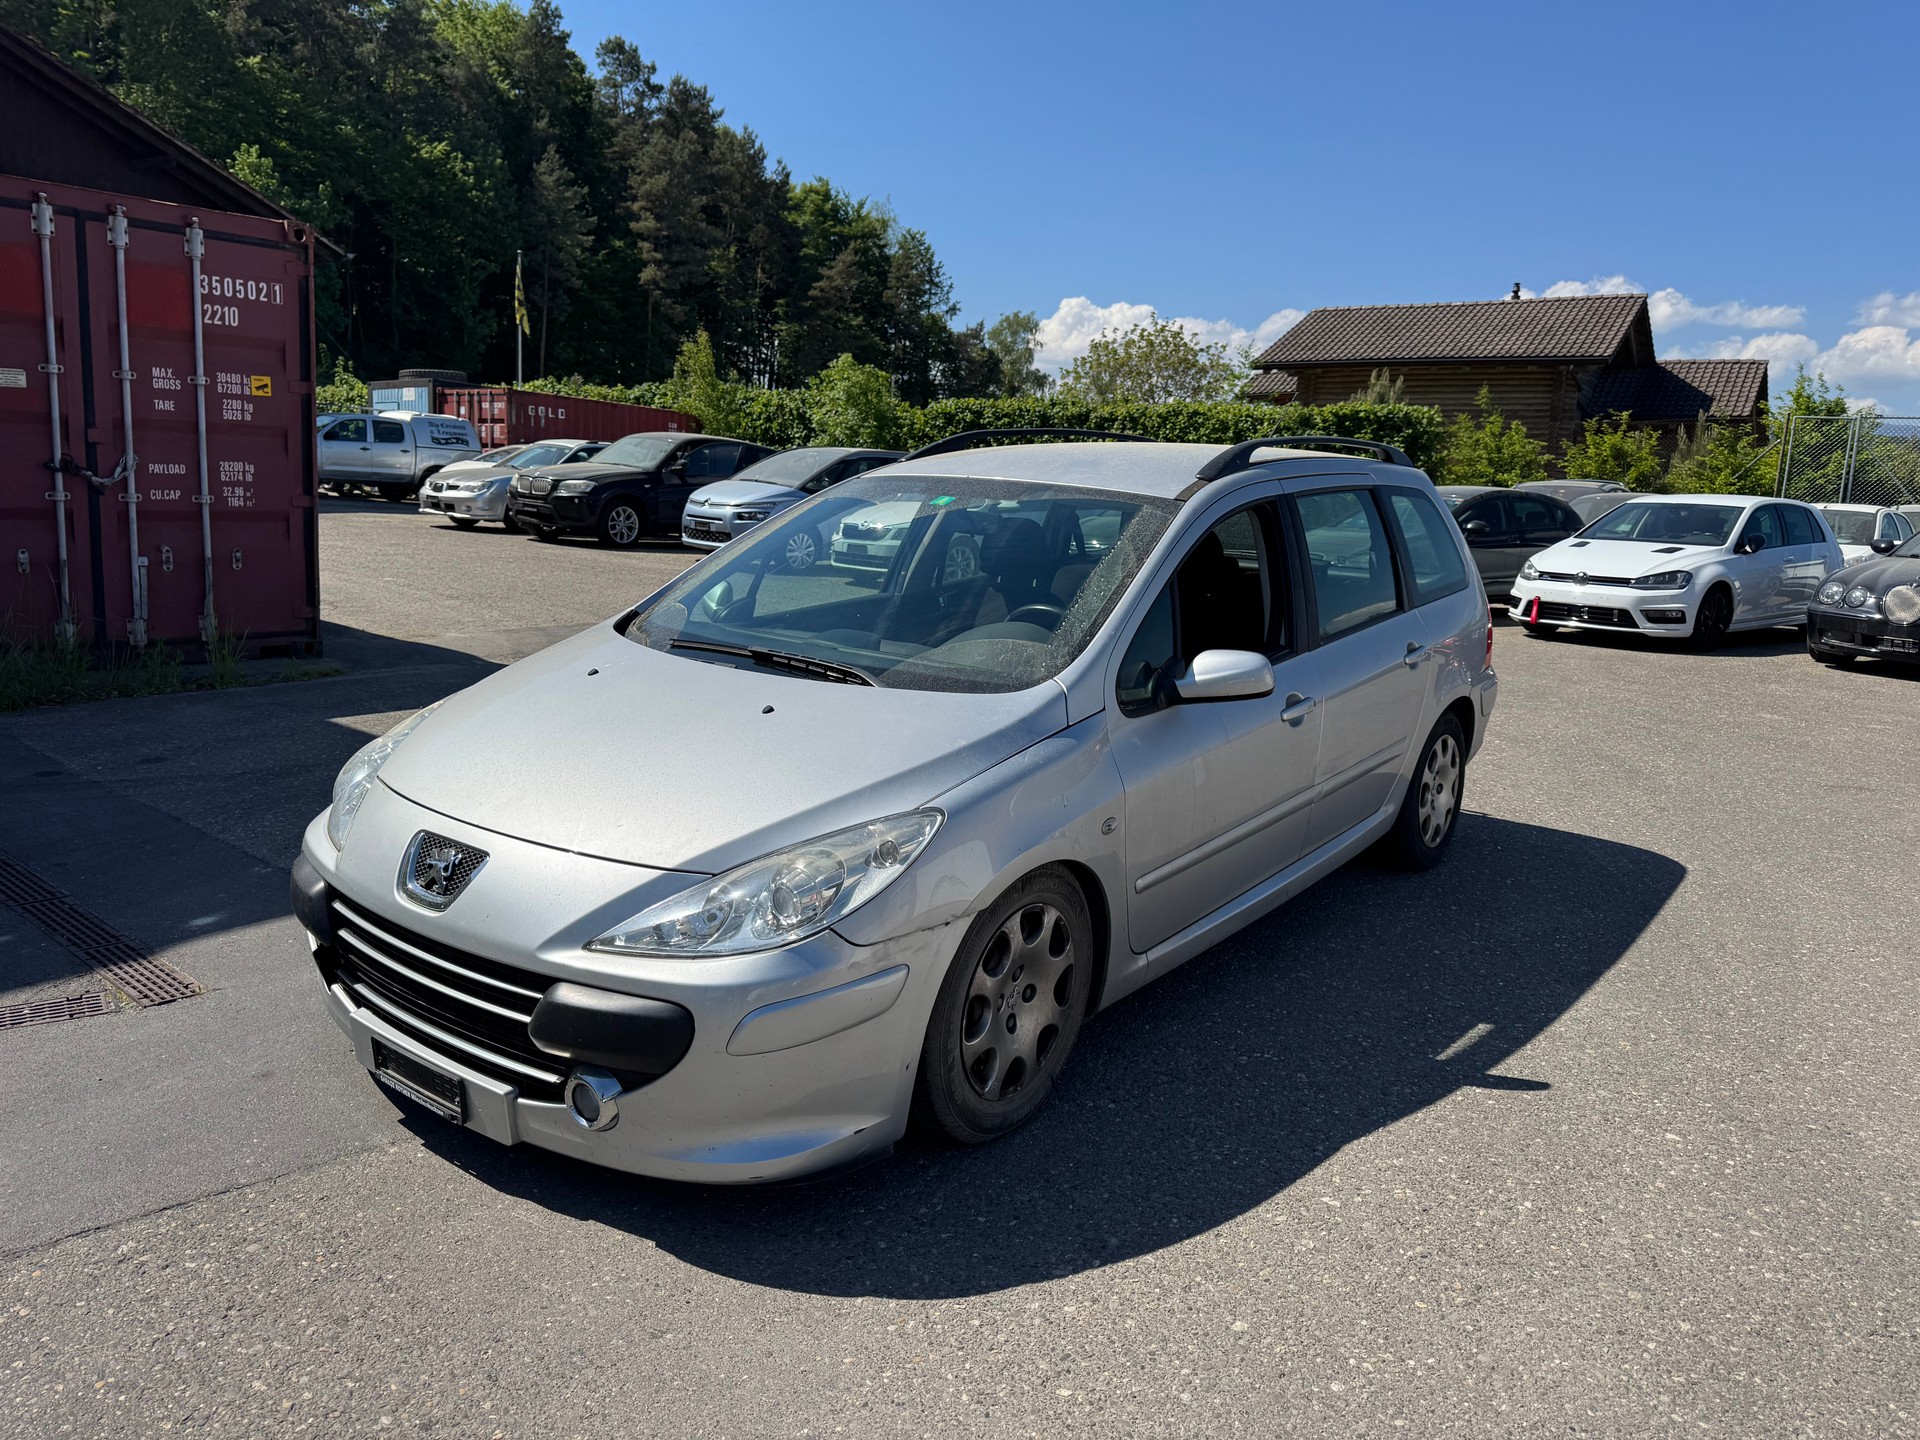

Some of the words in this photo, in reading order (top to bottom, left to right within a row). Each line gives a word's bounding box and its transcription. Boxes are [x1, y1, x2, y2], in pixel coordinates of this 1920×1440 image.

[203, 303, 239, 327] 2210
[152, 366, 176, 379] MAX.
[216, 371, 241, 384] 30480
[152, 378, 181, 390] GROSS
[217, 383, 242, 395] 67200
[243, 384, 251, 396] lb
[153, 399, 175, 411] TARE
[222, 398, 242, 410] 2280
[244, 400, 253, 413] kg
[223, 409, 242, 420] 5026
[244, 410, 252, 421] lb
[148, 463, 186, 475] PAYLOAD
[220, 461, 244, 472] 28200
[245, 462, 255, 474] kg
[220, 471, 243, 482] 62174
[245, 472, 253, 482] lb
[150, 489, 181, 500] CU.CAP
[222, 486, 244, 497] 32.96
[227, 497, 244, 507] 1164
